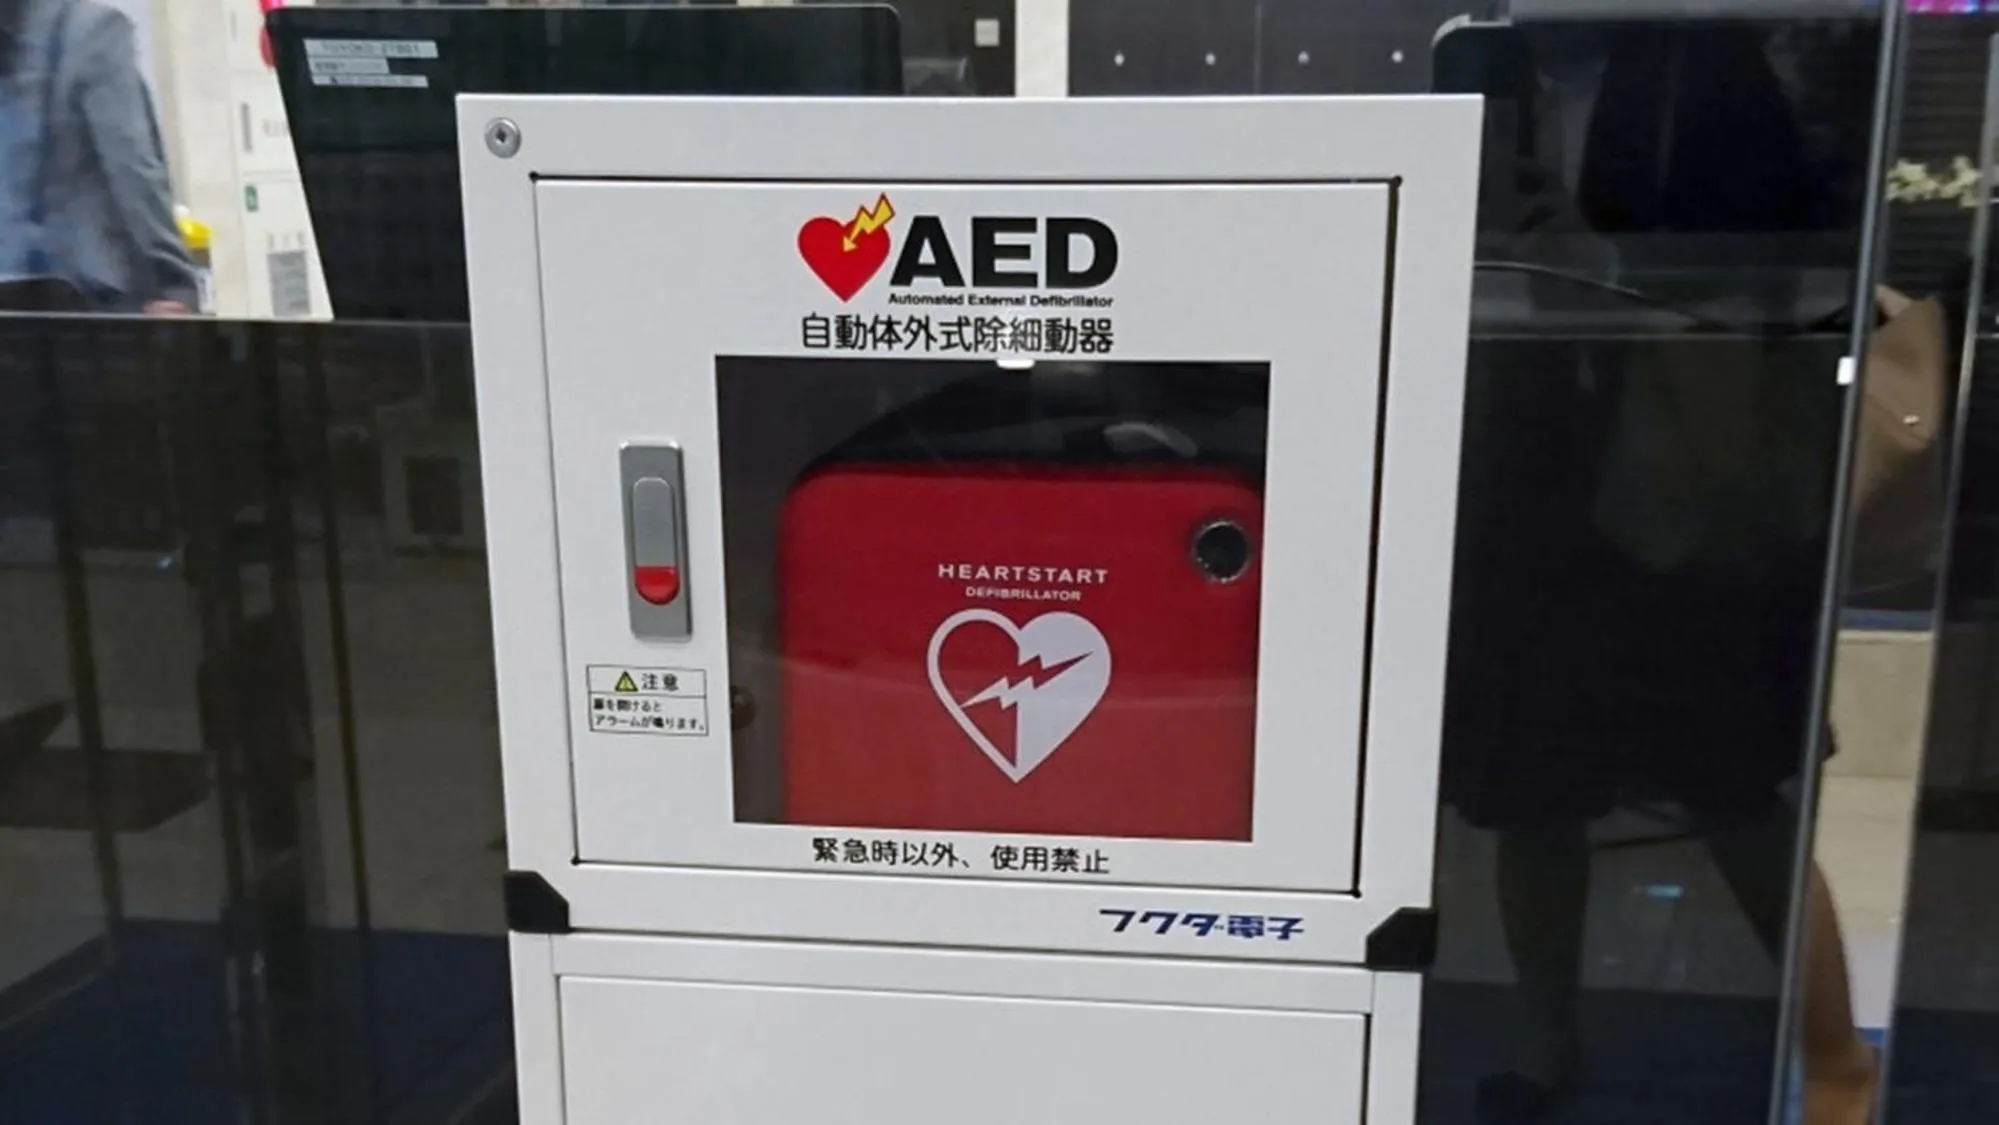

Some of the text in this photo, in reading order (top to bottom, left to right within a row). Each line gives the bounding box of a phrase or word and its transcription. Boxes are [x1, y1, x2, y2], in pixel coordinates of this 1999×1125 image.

[889, 216, 1119, 289] AED
[888, 293, 1114, 308] Automated External Defibrillator
[802, 312, 1114, 354] 自動体外式除細動器
[938, 564, 1108, 584] HEARTSTART
[965, 585, 1082, 602] DEFIBRILLATOR
[641, 673, 679, 692] 注意
[593, 698, 662, 713] を開けると
[811, 836, 1110, 875] 緊急時以外、使用禁止
[1099, 908, 1305, 941] フクダ電子
